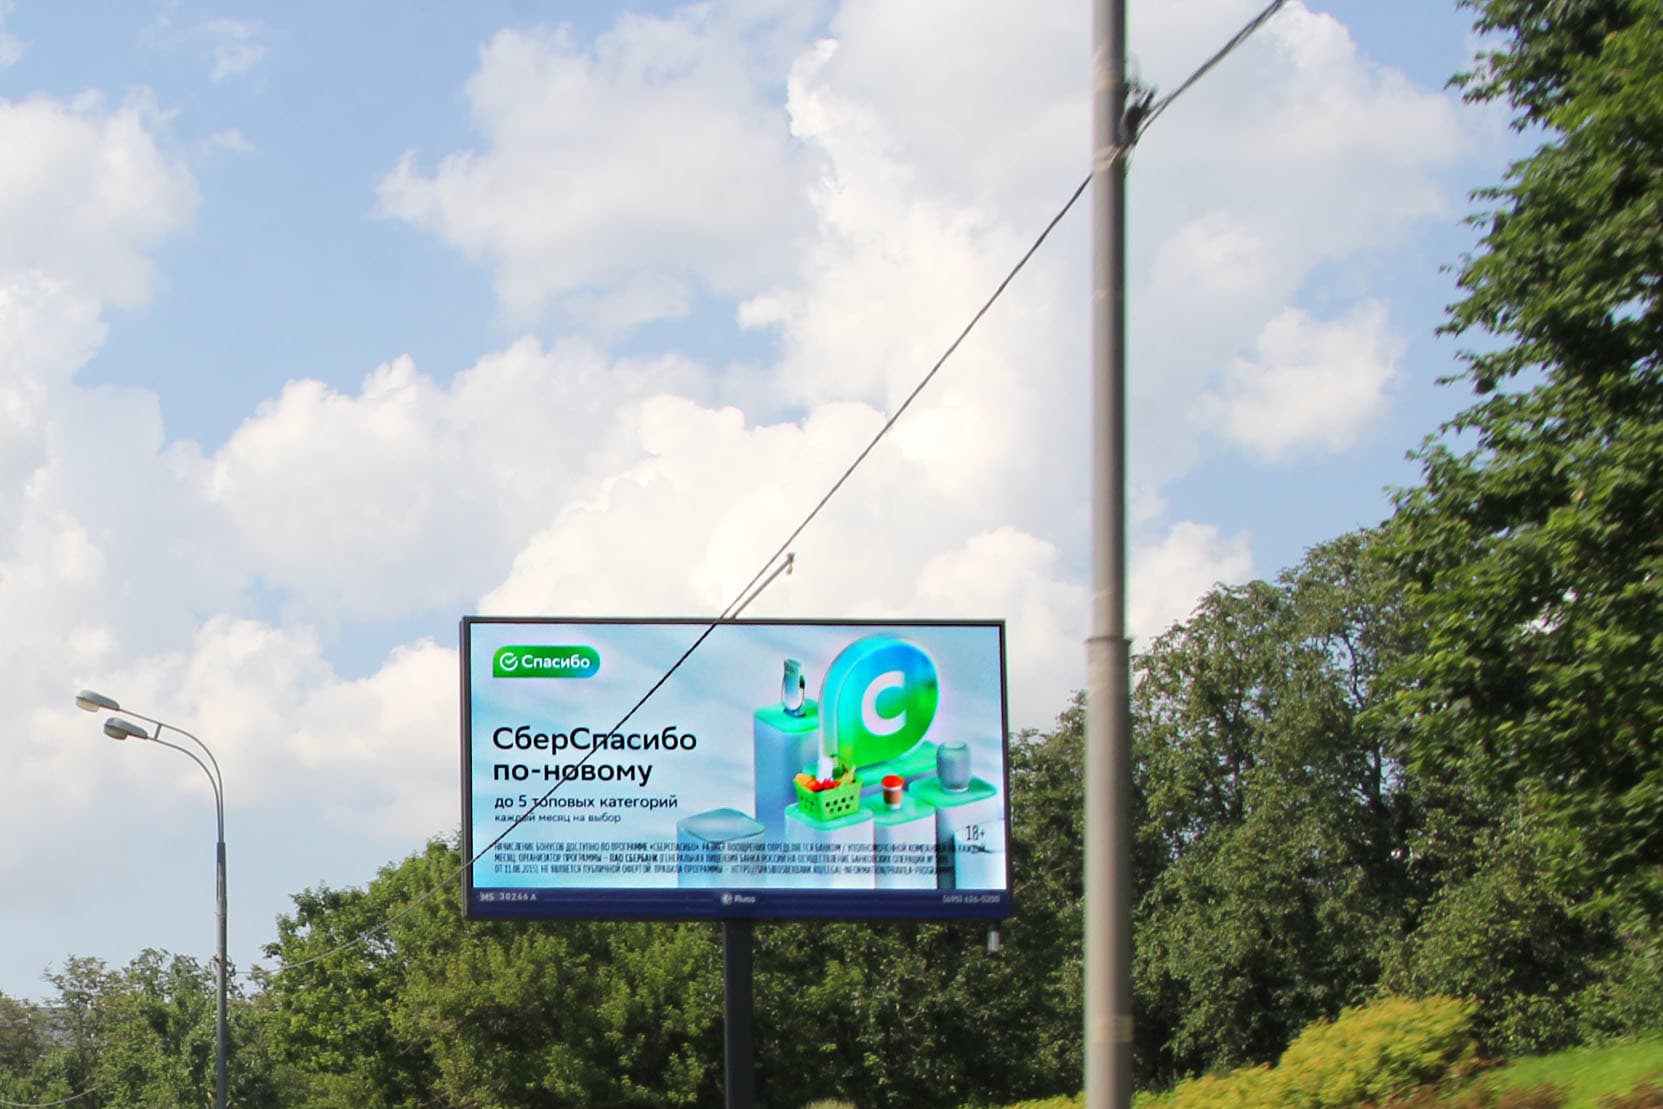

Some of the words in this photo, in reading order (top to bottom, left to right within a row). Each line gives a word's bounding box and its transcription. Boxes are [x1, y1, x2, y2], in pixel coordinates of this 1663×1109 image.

[521, 653, 591, 669] Спасибо
[492, 725, 697, 756] СберСпасибо
[493, 763, 653, 787] по-новому
[494, 796, 514, 810] до
[518, 795, 527, 808] 5
[532, 797, 595, 808] топовых
[600, 795, 678, 811] категорий
[539, 814, 571, 823] месяц
[588, 813, 621, 823] выбор
[965, 825, 986, 841] 18+
